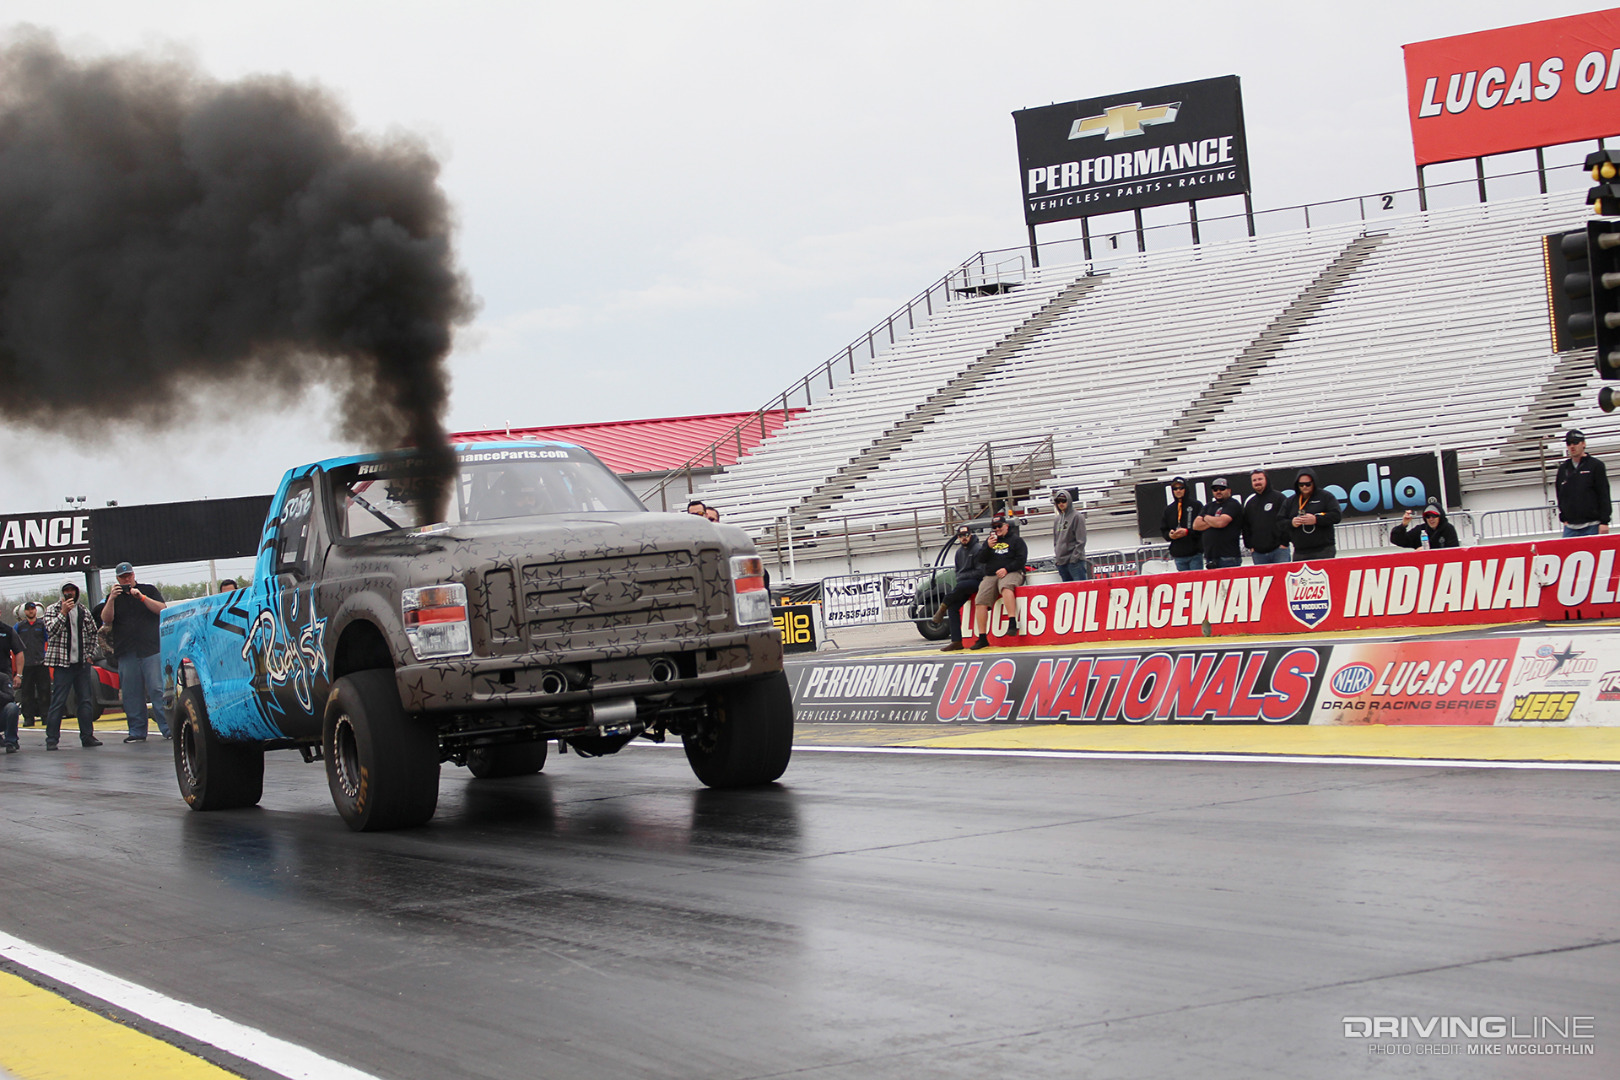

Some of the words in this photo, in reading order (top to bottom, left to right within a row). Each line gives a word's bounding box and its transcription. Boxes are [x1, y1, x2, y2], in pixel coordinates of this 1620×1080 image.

[1418, 57, 1565, 119] LUCAS
[1028, 135, 1234, 194] PERFORMANCE
[1030, 192, 1100, 212] VEHICLES
[1117, 182, 1161, 197] PARTS
[1178, 170, 1236, 187] RACING
[1382, 195, 1394, 210] 2
[1108, 235, 1118, 249] 1
[23, 555, 91, 569] RACING
[1053, 590, 1099, 635] OIL
[1105, 575, 1274, 631] RACEWAY
[1294, 585, 1326, 600] LUCAS
[803, 663, 945, 698] PERFORMANCE
[936, 658, 1016, 722] U.S.
[1016, 647, 1320, 722] NATIONALS
[1335, 668, 1371, 692] NHRA
[1371, 659, 1463, 696] LUCAS
[1461, 658, 1509, 695] OIL
[1513, 656, 1559, 687] PRO
[1558, 657, 1598, 677] MOD
[796, 710, 841, 721] VEHICLES
[850, 710, 880, 721] PARTS
[888, 710, 929, 721] RACING
[1321, 701, 1366, 710] DRAG
[1369, 700, 1432, 710] RACING
[1435, 700, 1497, 710] SERIES
[1508, 691, 1580, 721] JEGS
